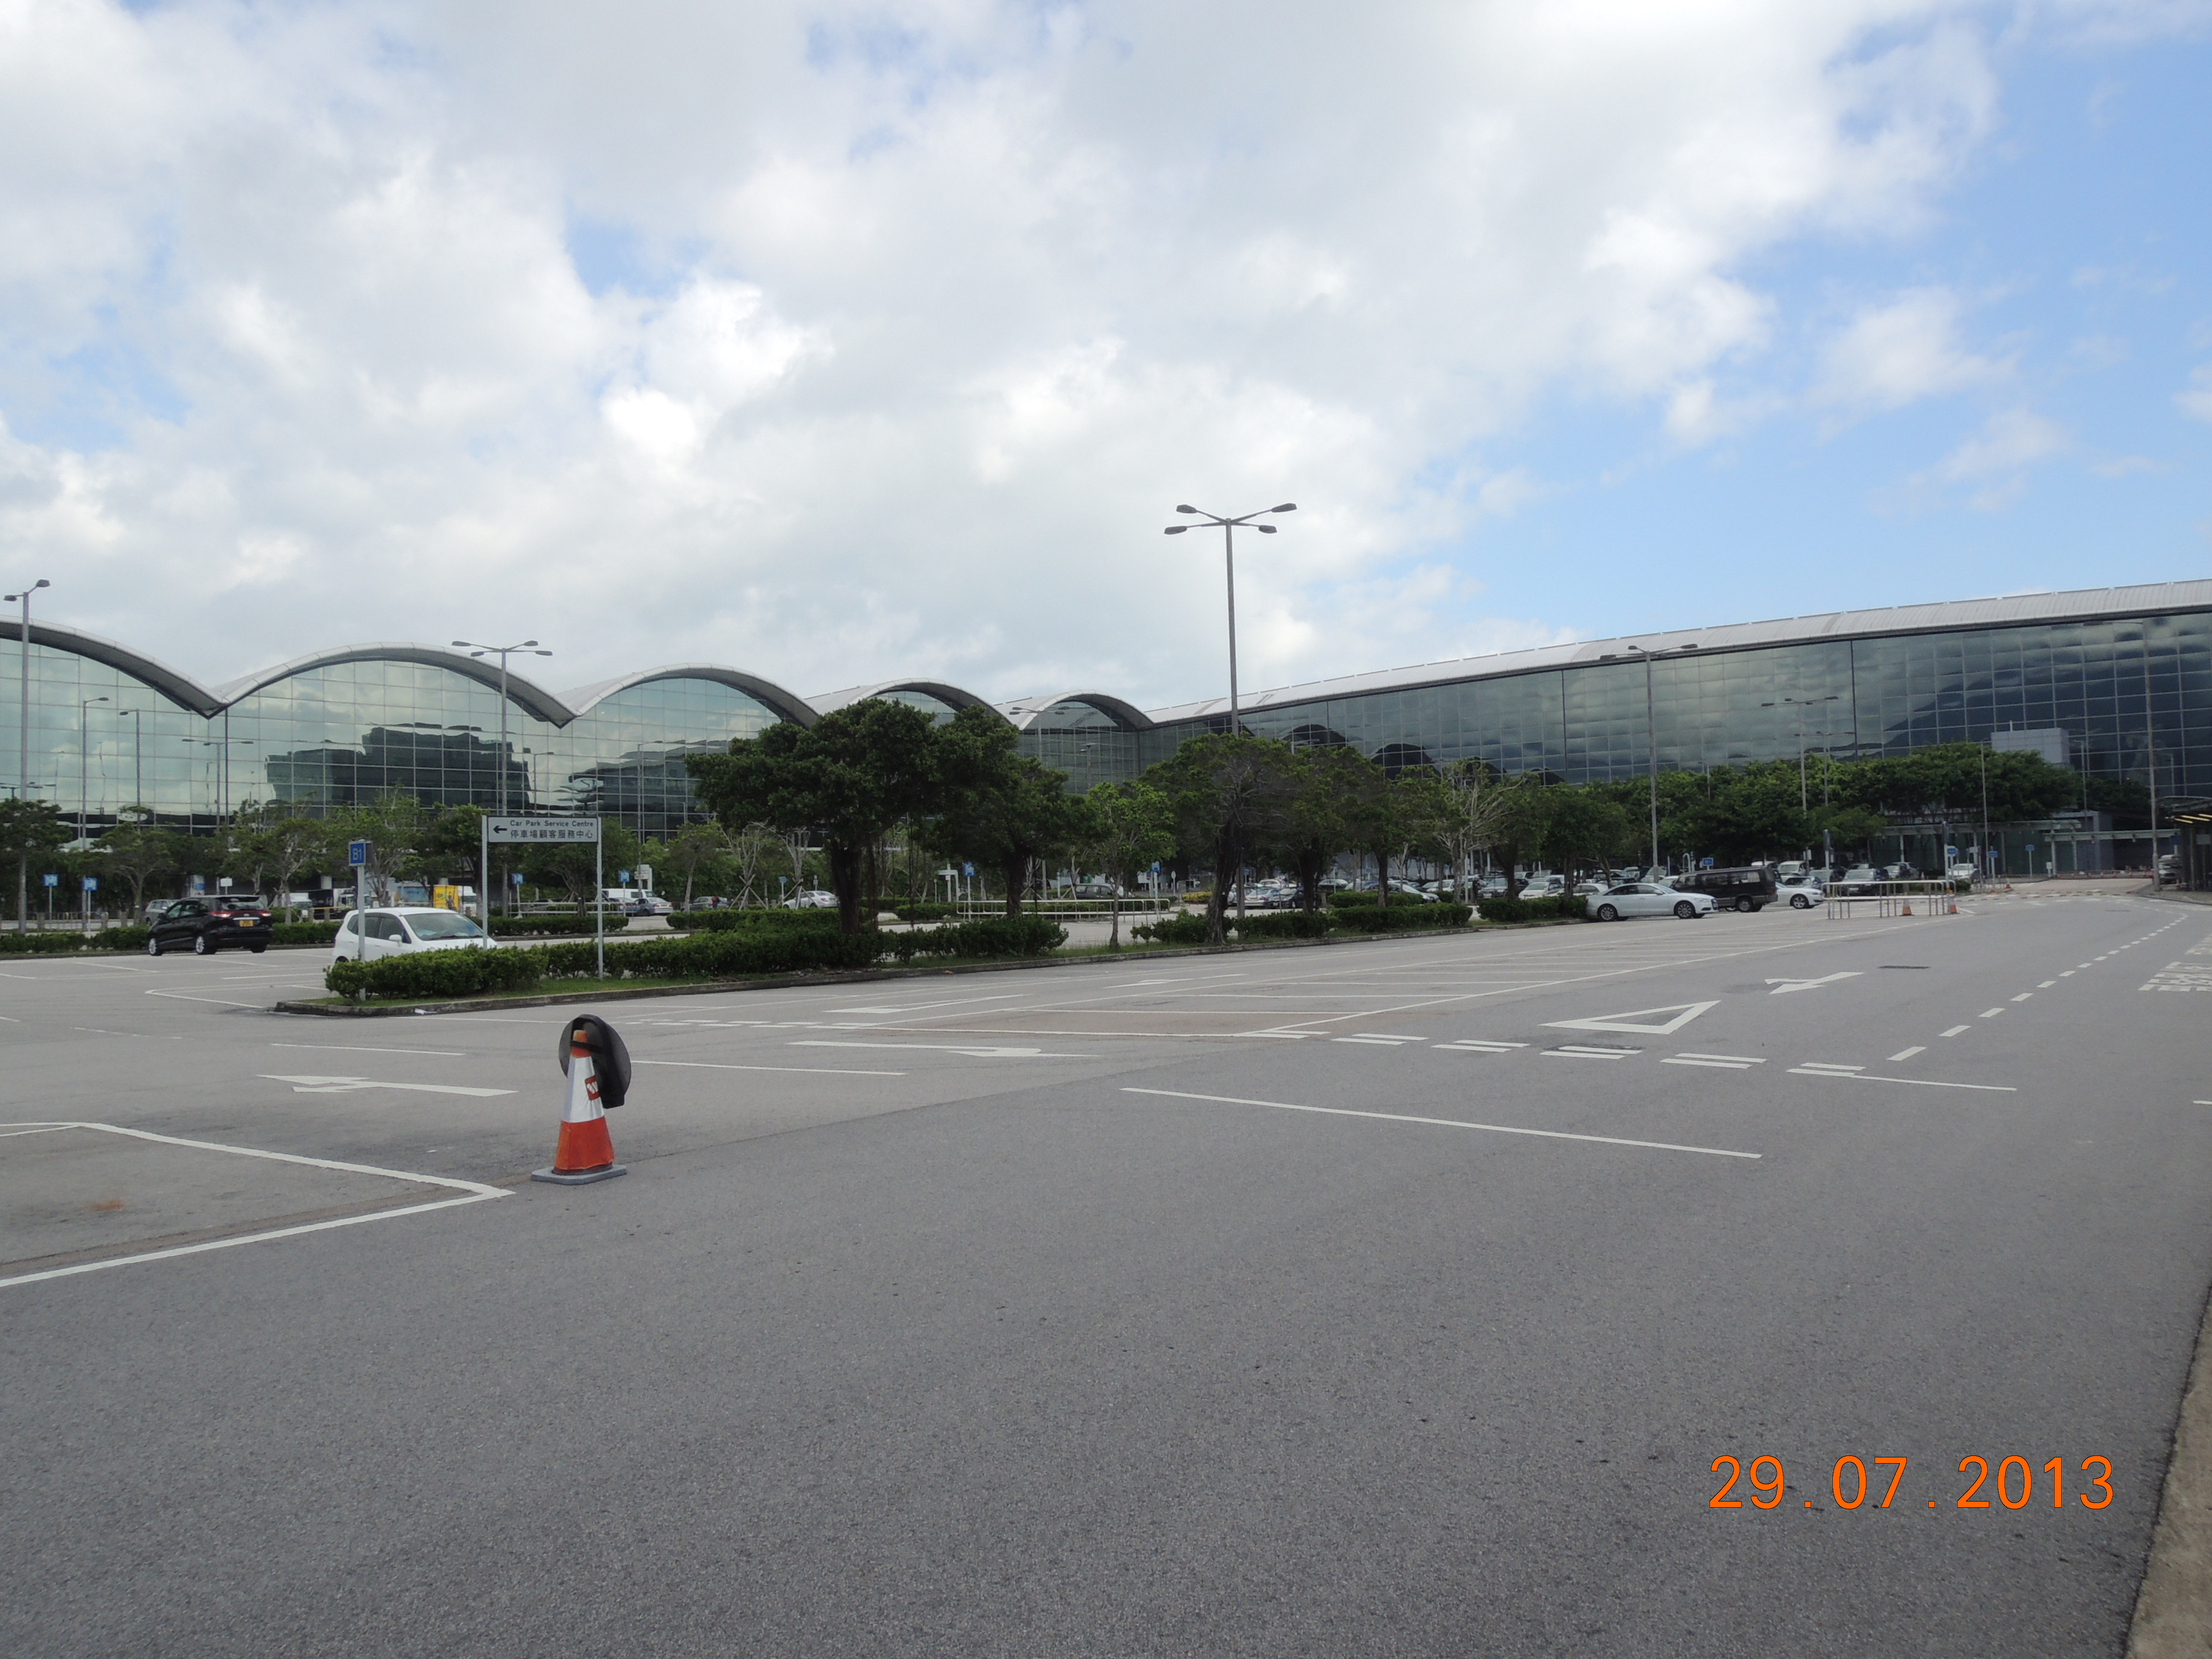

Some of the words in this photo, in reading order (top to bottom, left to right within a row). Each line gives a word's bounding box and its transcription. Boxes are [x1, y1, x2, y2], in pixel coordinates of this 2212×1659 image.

[510, 829, 593, 839] 停車場顧客服務中心
[353, 848, 362, 860] B1
